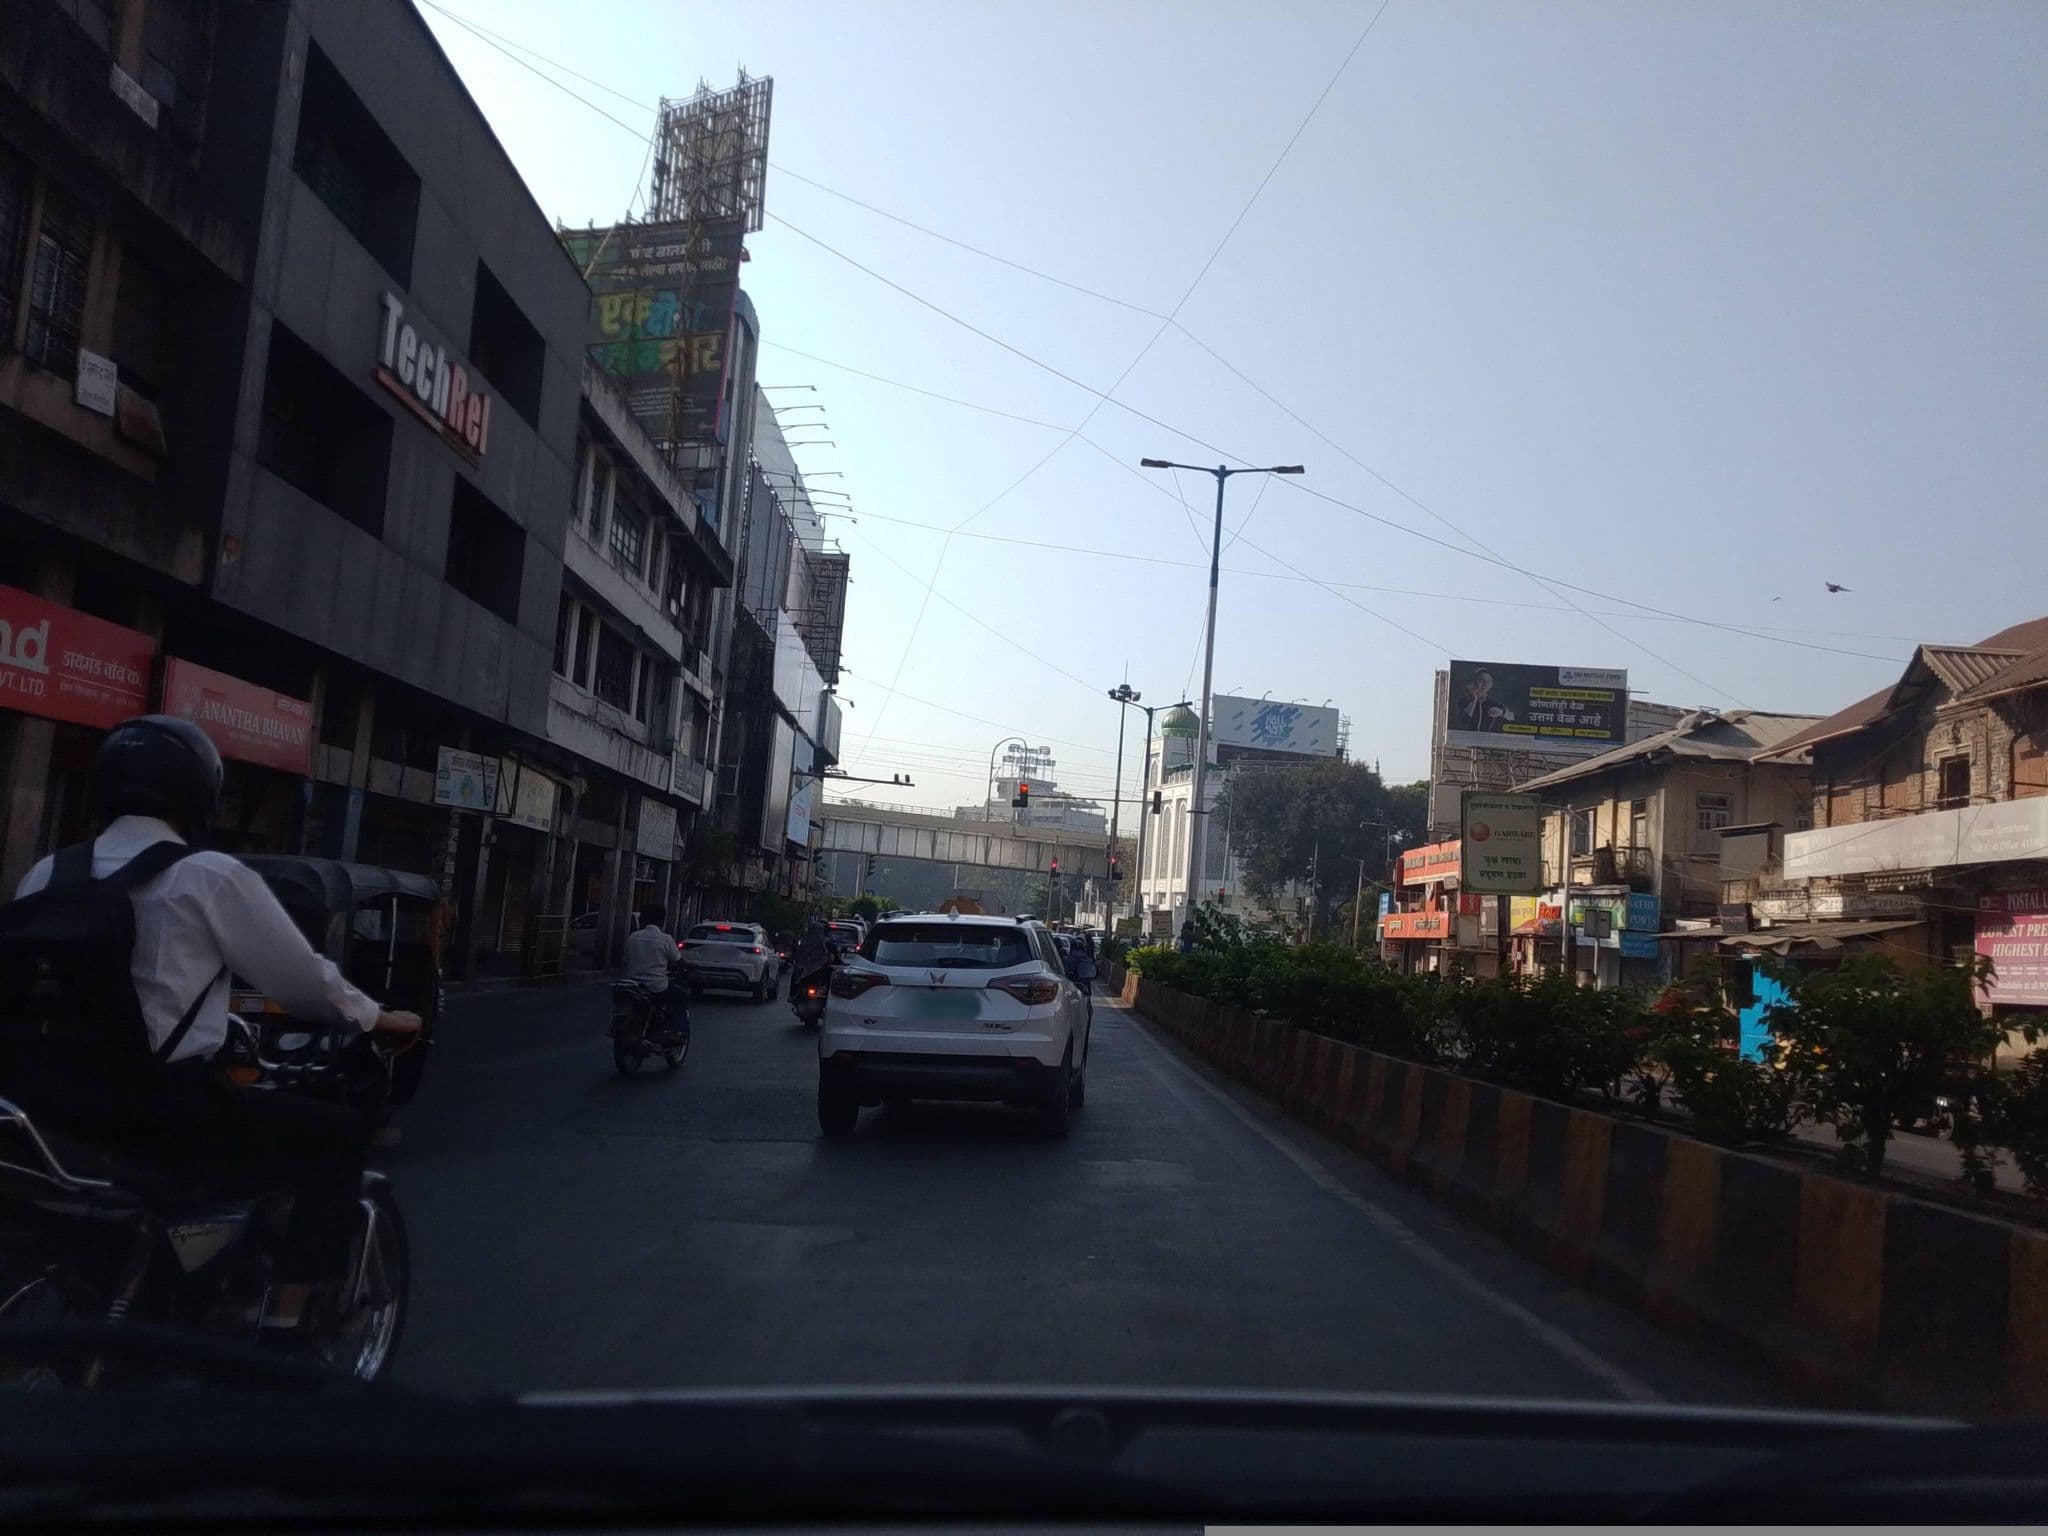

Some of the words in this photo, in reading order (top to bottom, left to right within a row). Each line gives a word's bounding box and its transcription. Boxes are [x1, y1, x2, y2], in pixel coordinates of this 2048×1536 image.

[384, 291, 490, 456] TechRel
[20, 677, 47, 698] LTD.
[1529, 698, 1567, 711] कोणतीही
[202, 699, 261, 733] ANANTHA
[263, 719, 305, 745] BHAVAN
[1528, 711, 1554, 723] उत्तम
[1557, 711, 1576, 724] वेळ
[1579, 713, 1603, 727] आहे
[2008, 892, 2041, 912] POSTAL
[1982, 925, 2025, 938] LOWEST
[1992, 943, 2041, 957] HIGHEST
